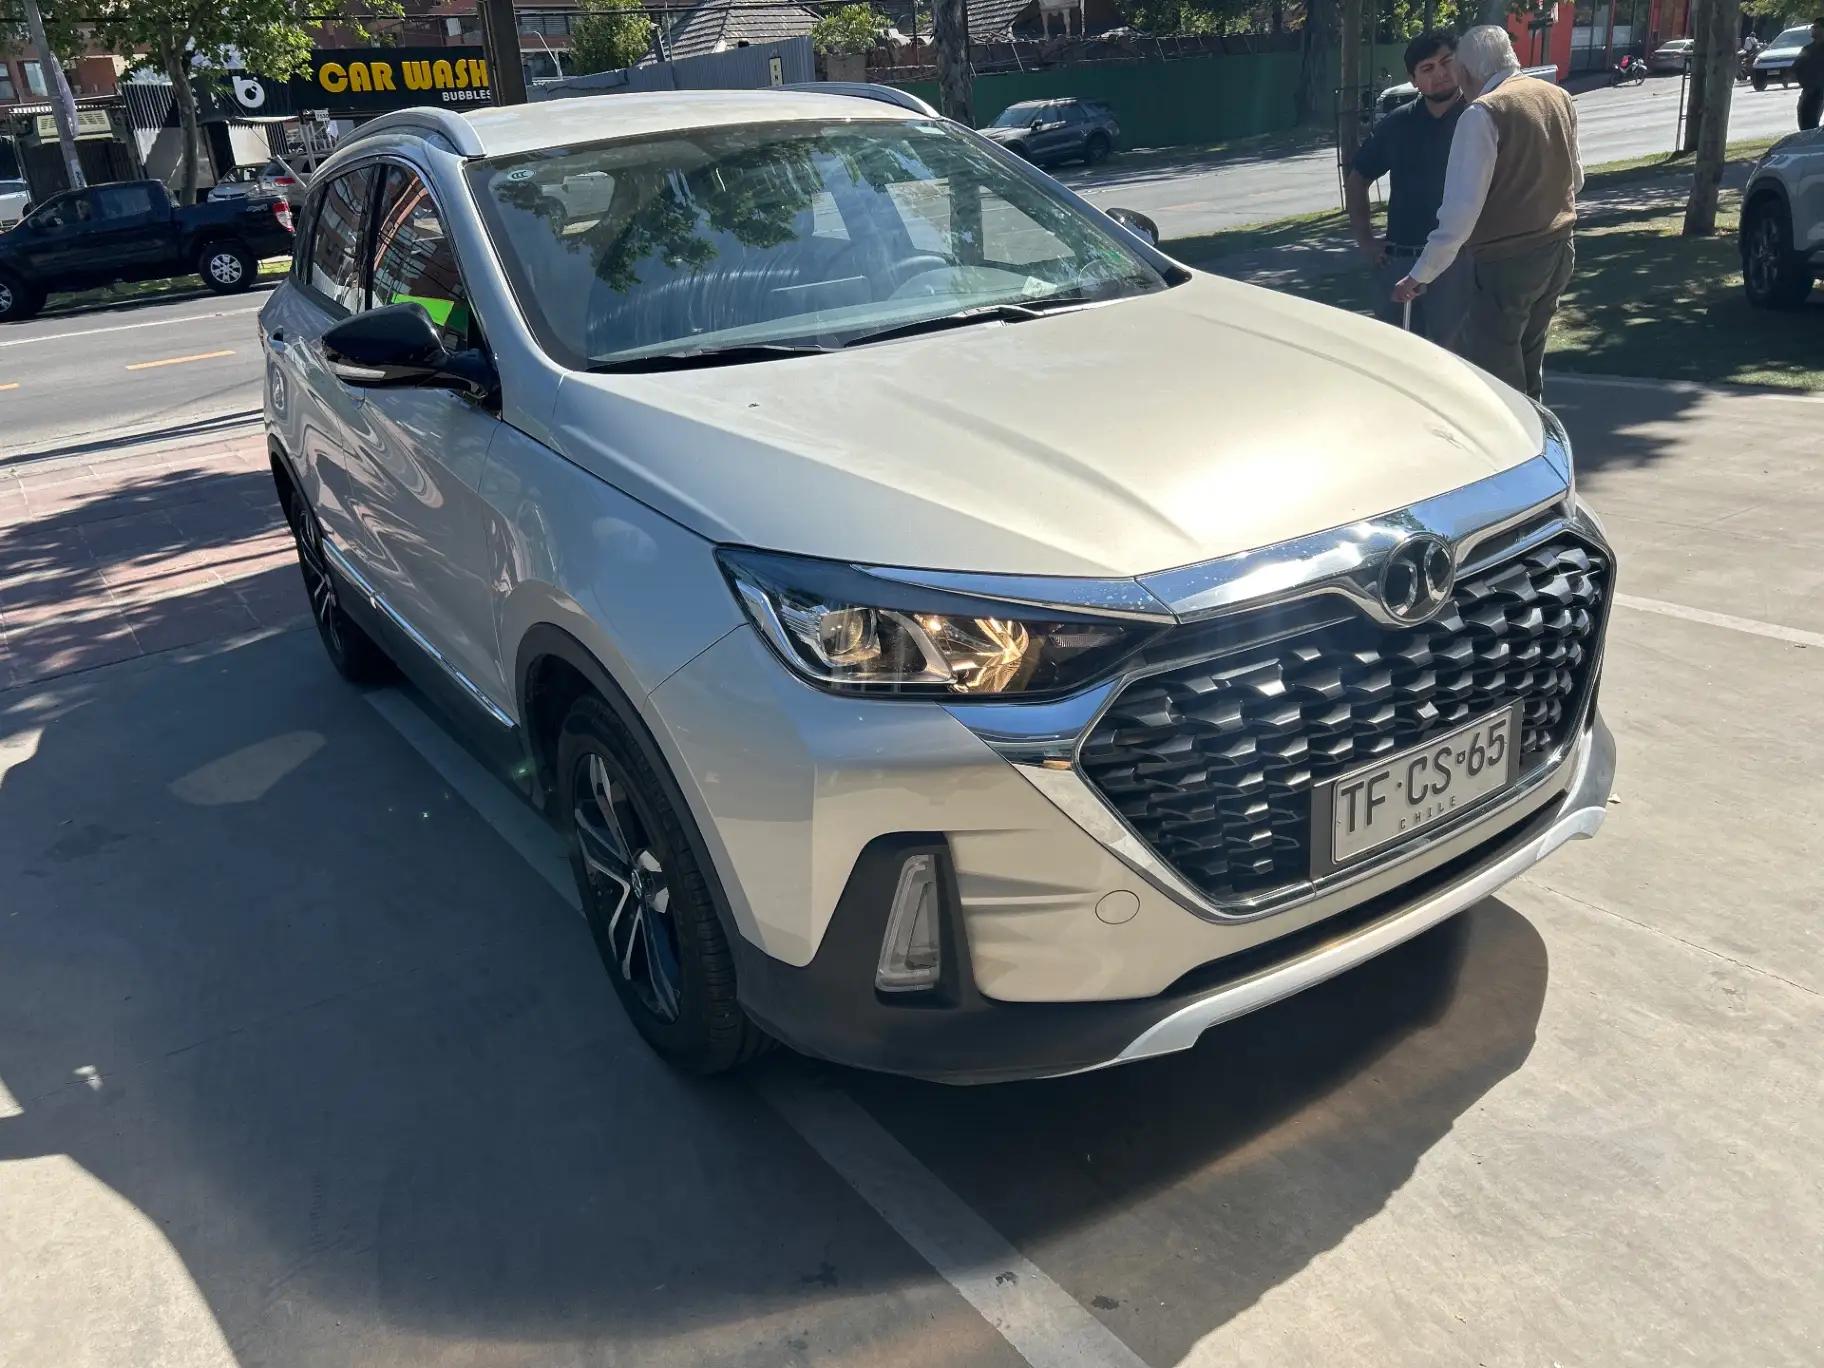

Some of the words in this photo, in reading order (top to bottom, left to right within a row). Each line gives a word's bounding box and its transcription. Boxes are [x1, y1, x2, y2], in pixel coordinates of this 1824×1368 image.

[319, 62, 396, 93] CAR
[402, 59, 489, 90] WASH
[442, 90, 491, 101] BUBBLES
[1399, 796, 1456, 830] CHILE
